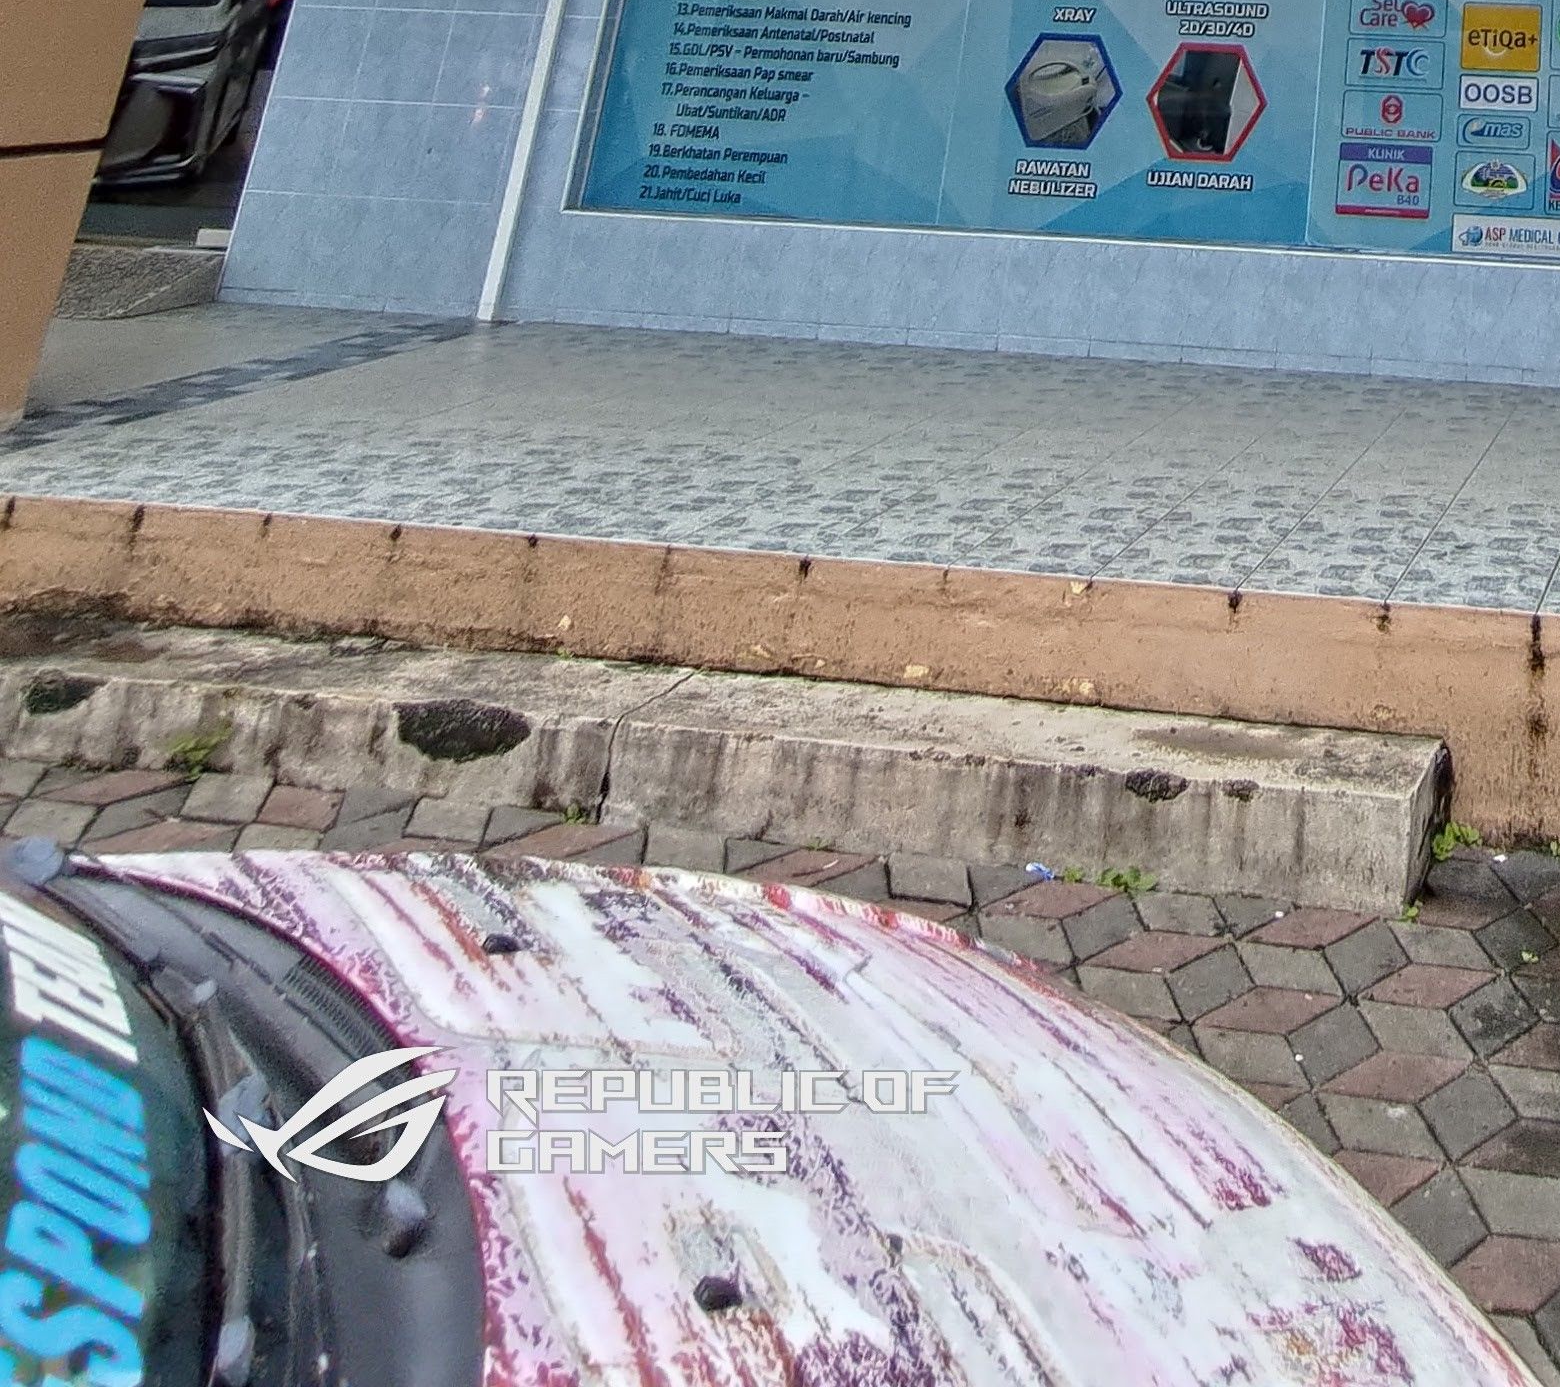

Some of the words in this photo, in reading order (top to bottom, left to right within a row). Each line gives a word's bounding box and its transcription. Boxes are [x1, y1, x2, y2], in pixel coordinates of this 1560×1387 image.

[764, 6, 808, 20] Makmal
[810, 8, 864, 24] Darah/Air
[867, 12, 912, 27] kencing
[1053, 7, 1095, 23] XRAY
[1166, 1, 1268, 19] ULTRASOUND
[1360, 8, 1398, 27] Care
[760, 26, 875, 44] Antenatal/Postnatal
[1179, 21, 1254, 37] 2D/3D/4D
[743, 45, 814, 62] Permohonan
[816, 49, 900, 68] baru/Sambung
[753, 66, 776, 82] Pap
[778, 70, 814, 82] smear
[749, 87, 800, 104] Keluarga
[1465, 83, 1533, 104] OOSB
[669, 125, 720, 139] FOMEMA
[1345, 127, 1394, 138] PUBLIC
[1397, 129, 1436, 140] BANK
[722, 148, 788, 165] Perempuan
[1368, 149, 1405, 161] KLINIK
[1016, 159, 1090, 177] RAWATAN
[737, 170, 766, 185] Kecil
[1147, 171, 1193, 187] UJIAN
[1197, 173, 1252, 190] DARAH
[713, 189, 742, 204] Luka
[1008, 179, 1097, 198] NEBULIZER
[1397, 194, 1420, 206] B40
[1485, 227, 1506, 243] ASP
[1508, 229, 1554, 245] MEDICAL
